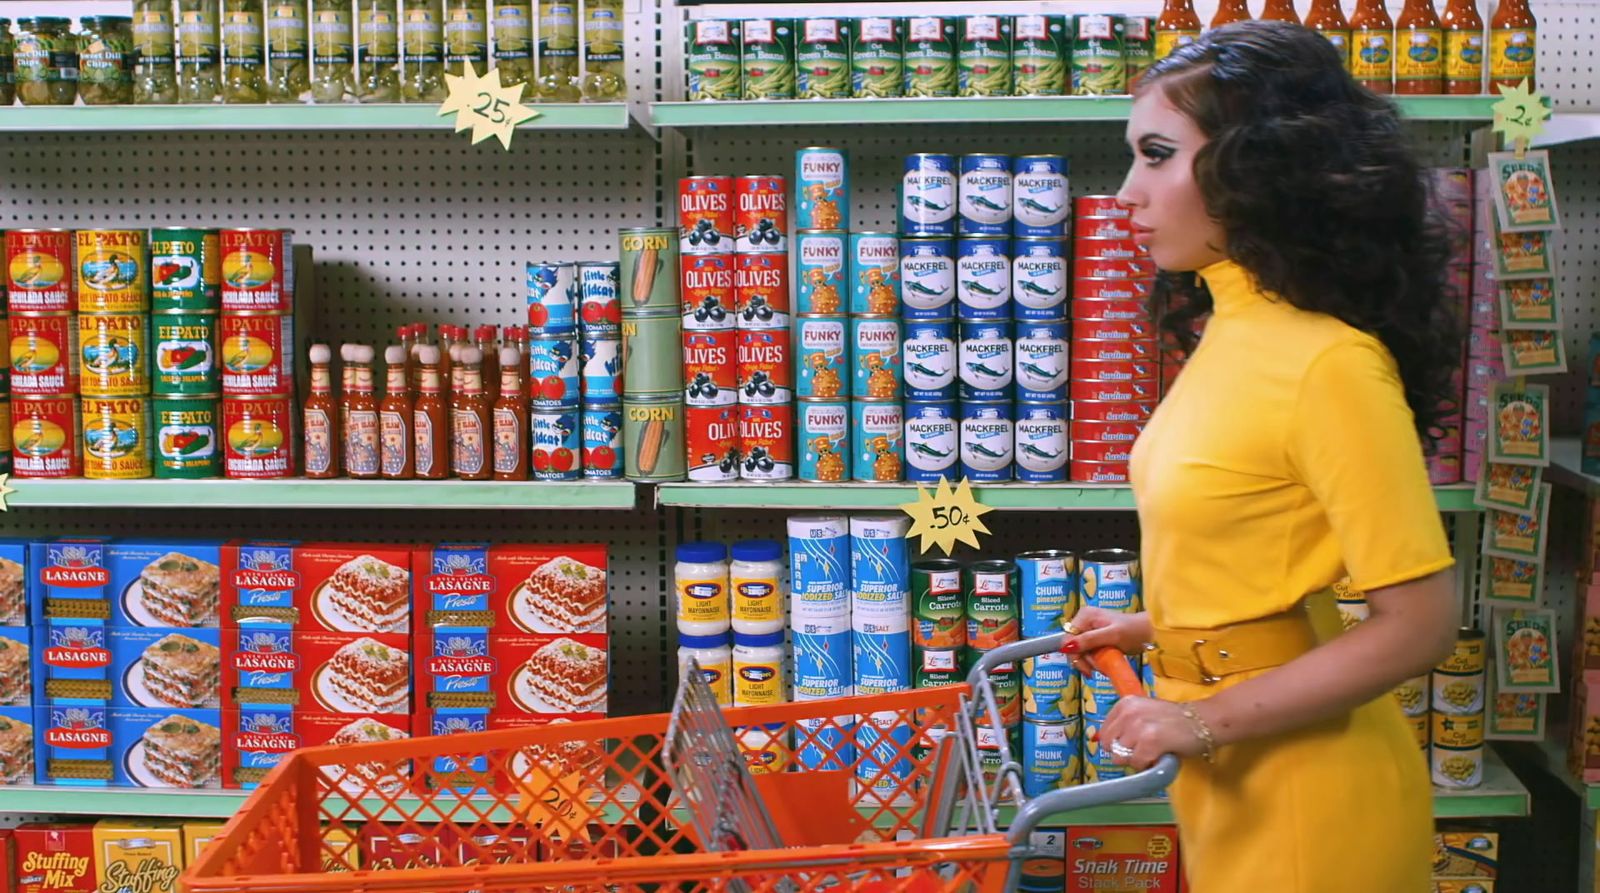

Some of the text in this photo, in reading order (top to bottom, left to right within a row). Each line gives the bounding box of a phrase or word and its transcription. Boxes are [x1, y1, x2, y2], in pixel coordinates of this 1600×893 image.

[104, 52, 121, 60] Dill
[87, 60, 111, 68] Chips
[803, 162, 840, 172] FUNKY
[681, 194, 727, 212] OLIVES
[740, 193, 785, 211] OLIVES
[22, 234, 66, 248] PATO
[78, 232, 140, 246] EL PATO
[232, 233, 276, 247] PATO
[623, 236, 668, 250] CORN
[162, 241, 195, 254] PATO
[803, 246, 840, 258] FUNKY
[860, 246, 897, 257] FUNKY
[686, 270, 732, 288] OLIVES
[737, 270, 780, 287] OLIVES
[44, 290, 68, 304] SAUCE
[258, 290, 280, 304] SAUCE
[18, 318, 60, 331] PATO
[94, 316, 140, 330] PATO
[232, 318, 274, 331] PATO
[586, 324, 618, 332] TOMATOES
[177, 326, 208, 338] PATO
[804, 330, 841, 341] FUNKY
[860, 330, 896, 341] FUNKY
[685, 347, 726, 364] OLIVES
[739, 346, 782, 362] OLIVES
[39, 374, 64, 387] SAUCE
[252, 374, 277, 387] SAUCE
[24, 402, 66, 414] PATO
[96, 400, 140, 414] PATO
[240, 402, 284, 415] PATO
[180, 411, 212, 424] PATO
[629, 408, 674, 422] CORN
[808, 414, 844, 425] FUNKY
[865, 414, 902, 425] FUNKY
[740, 421, 782, 438] OLIVES
[46, 458, 70, 470] SAUCE
[264, 458, 288, 470] SAUCE
[535, 472, 565, 480] TOMATOES
[46, 570, 106, 581] LASAGNE
[236, 576, 296, 587] LASAGNE
[429, 580, 490, 591] LASAGNE
[806, 583, 844, 592] SUPERIOR
[860, 583, 898, 592] SUPERIOR
[1036, 586, 1063, 596] CHUNK
[938, 594, 956, 602] Sliced
[1036, 596, 1067, 604] pineapple
[1098, 590, 1126, 599] CHUNK
[928, 601, 962, 610] Carrots
[974, 603, 1009, 611] Carrots
[1098, 599, 1129, 608] pineapple
[740, 606, 772, 614] MAYONNAISE
[48, 651, 106, 662] LASAGNE
[236, 658, 294, 668] LASAGNE
[430, 662, 492, 673] LASAGNE
[1036, 670, 1063, 679] CHUNK
[802, 678, 838, 687] SUPERIOR
[860, 678, 898, 687] SUPERIOR
[1036, 679, 1068, 687] pineapple
[50, 732, 108, 742] LASAGNE
[236, 738, 296, 750] LASAGNE
[1035, 750, 1062, 759] CHUNK
[1035, 759, 1066, 767] pineapple
[1046, 835, 1056, 846] 2
[22, 851, 89, 877] Stuffing
[1072, 859, 1168, 874] Snak Time
[42, 872, 76, 889] Mix
[101, 860, 178, 893] Stuffing
[1078, 876, 1161, 888] Stack Pack
